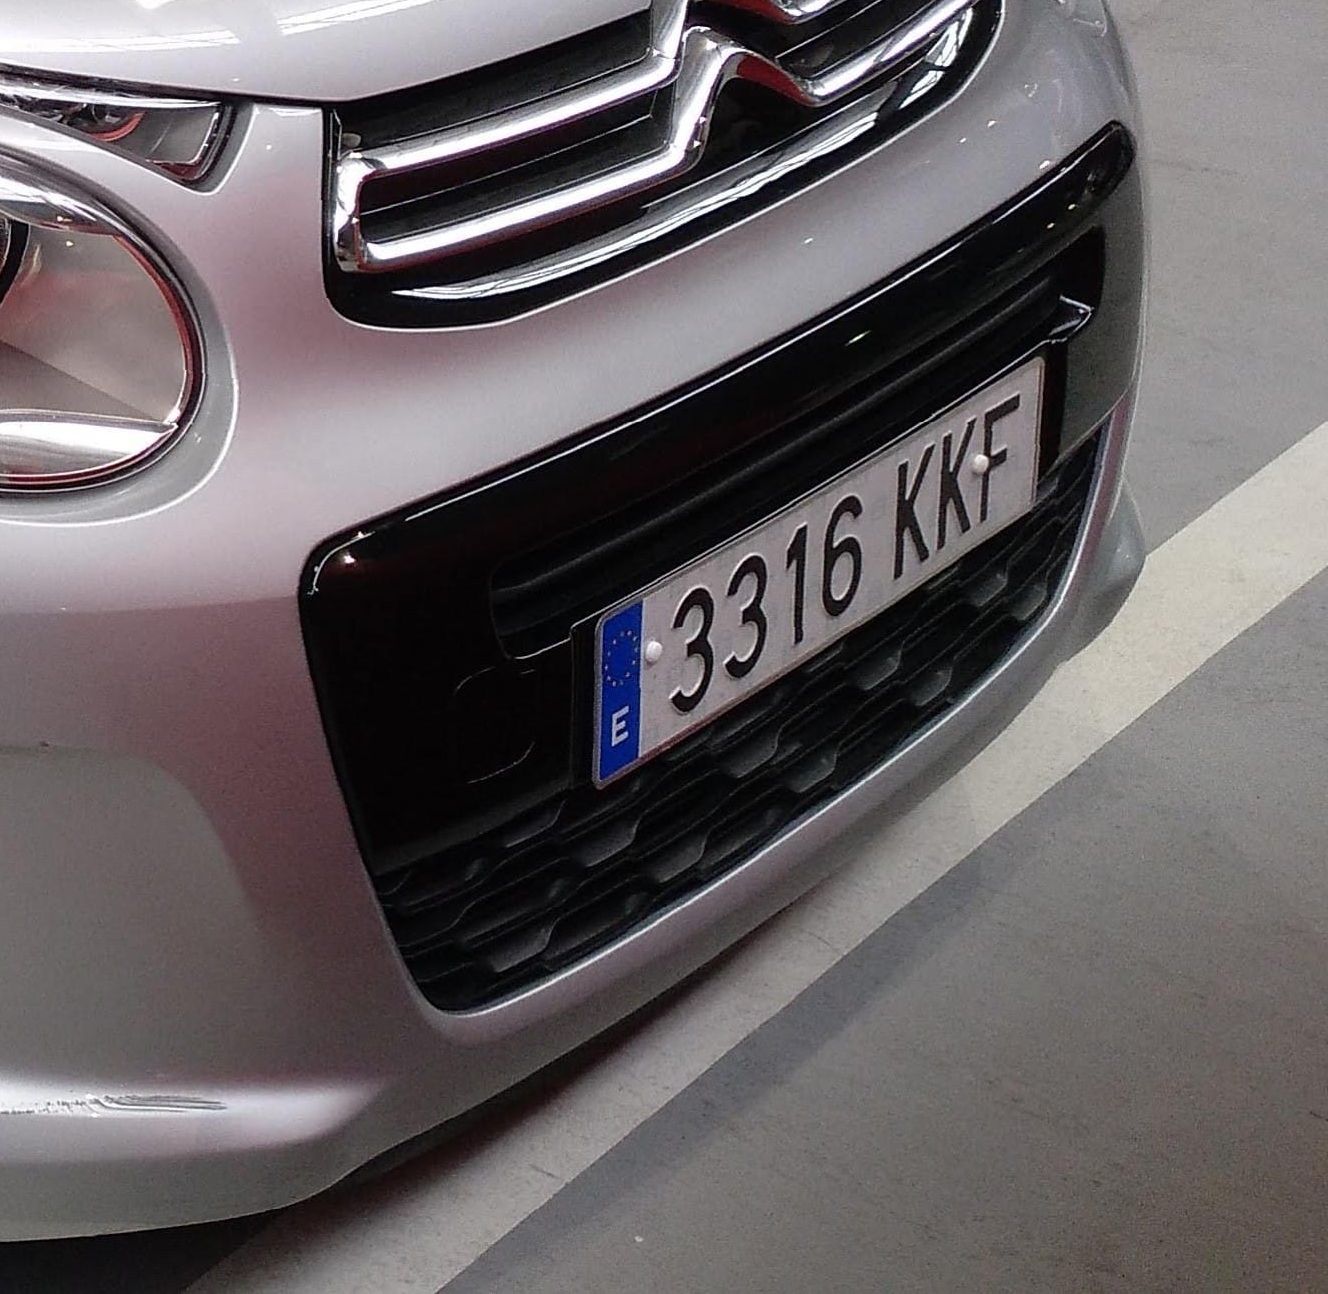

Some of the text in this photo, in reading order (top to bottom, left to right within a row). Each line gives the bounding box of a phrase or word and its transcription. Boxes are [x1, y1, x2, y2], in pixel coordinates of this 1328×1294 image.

[668, 393, 1021, 714] 3316 KKF
[610, 706, 630, 748] E
